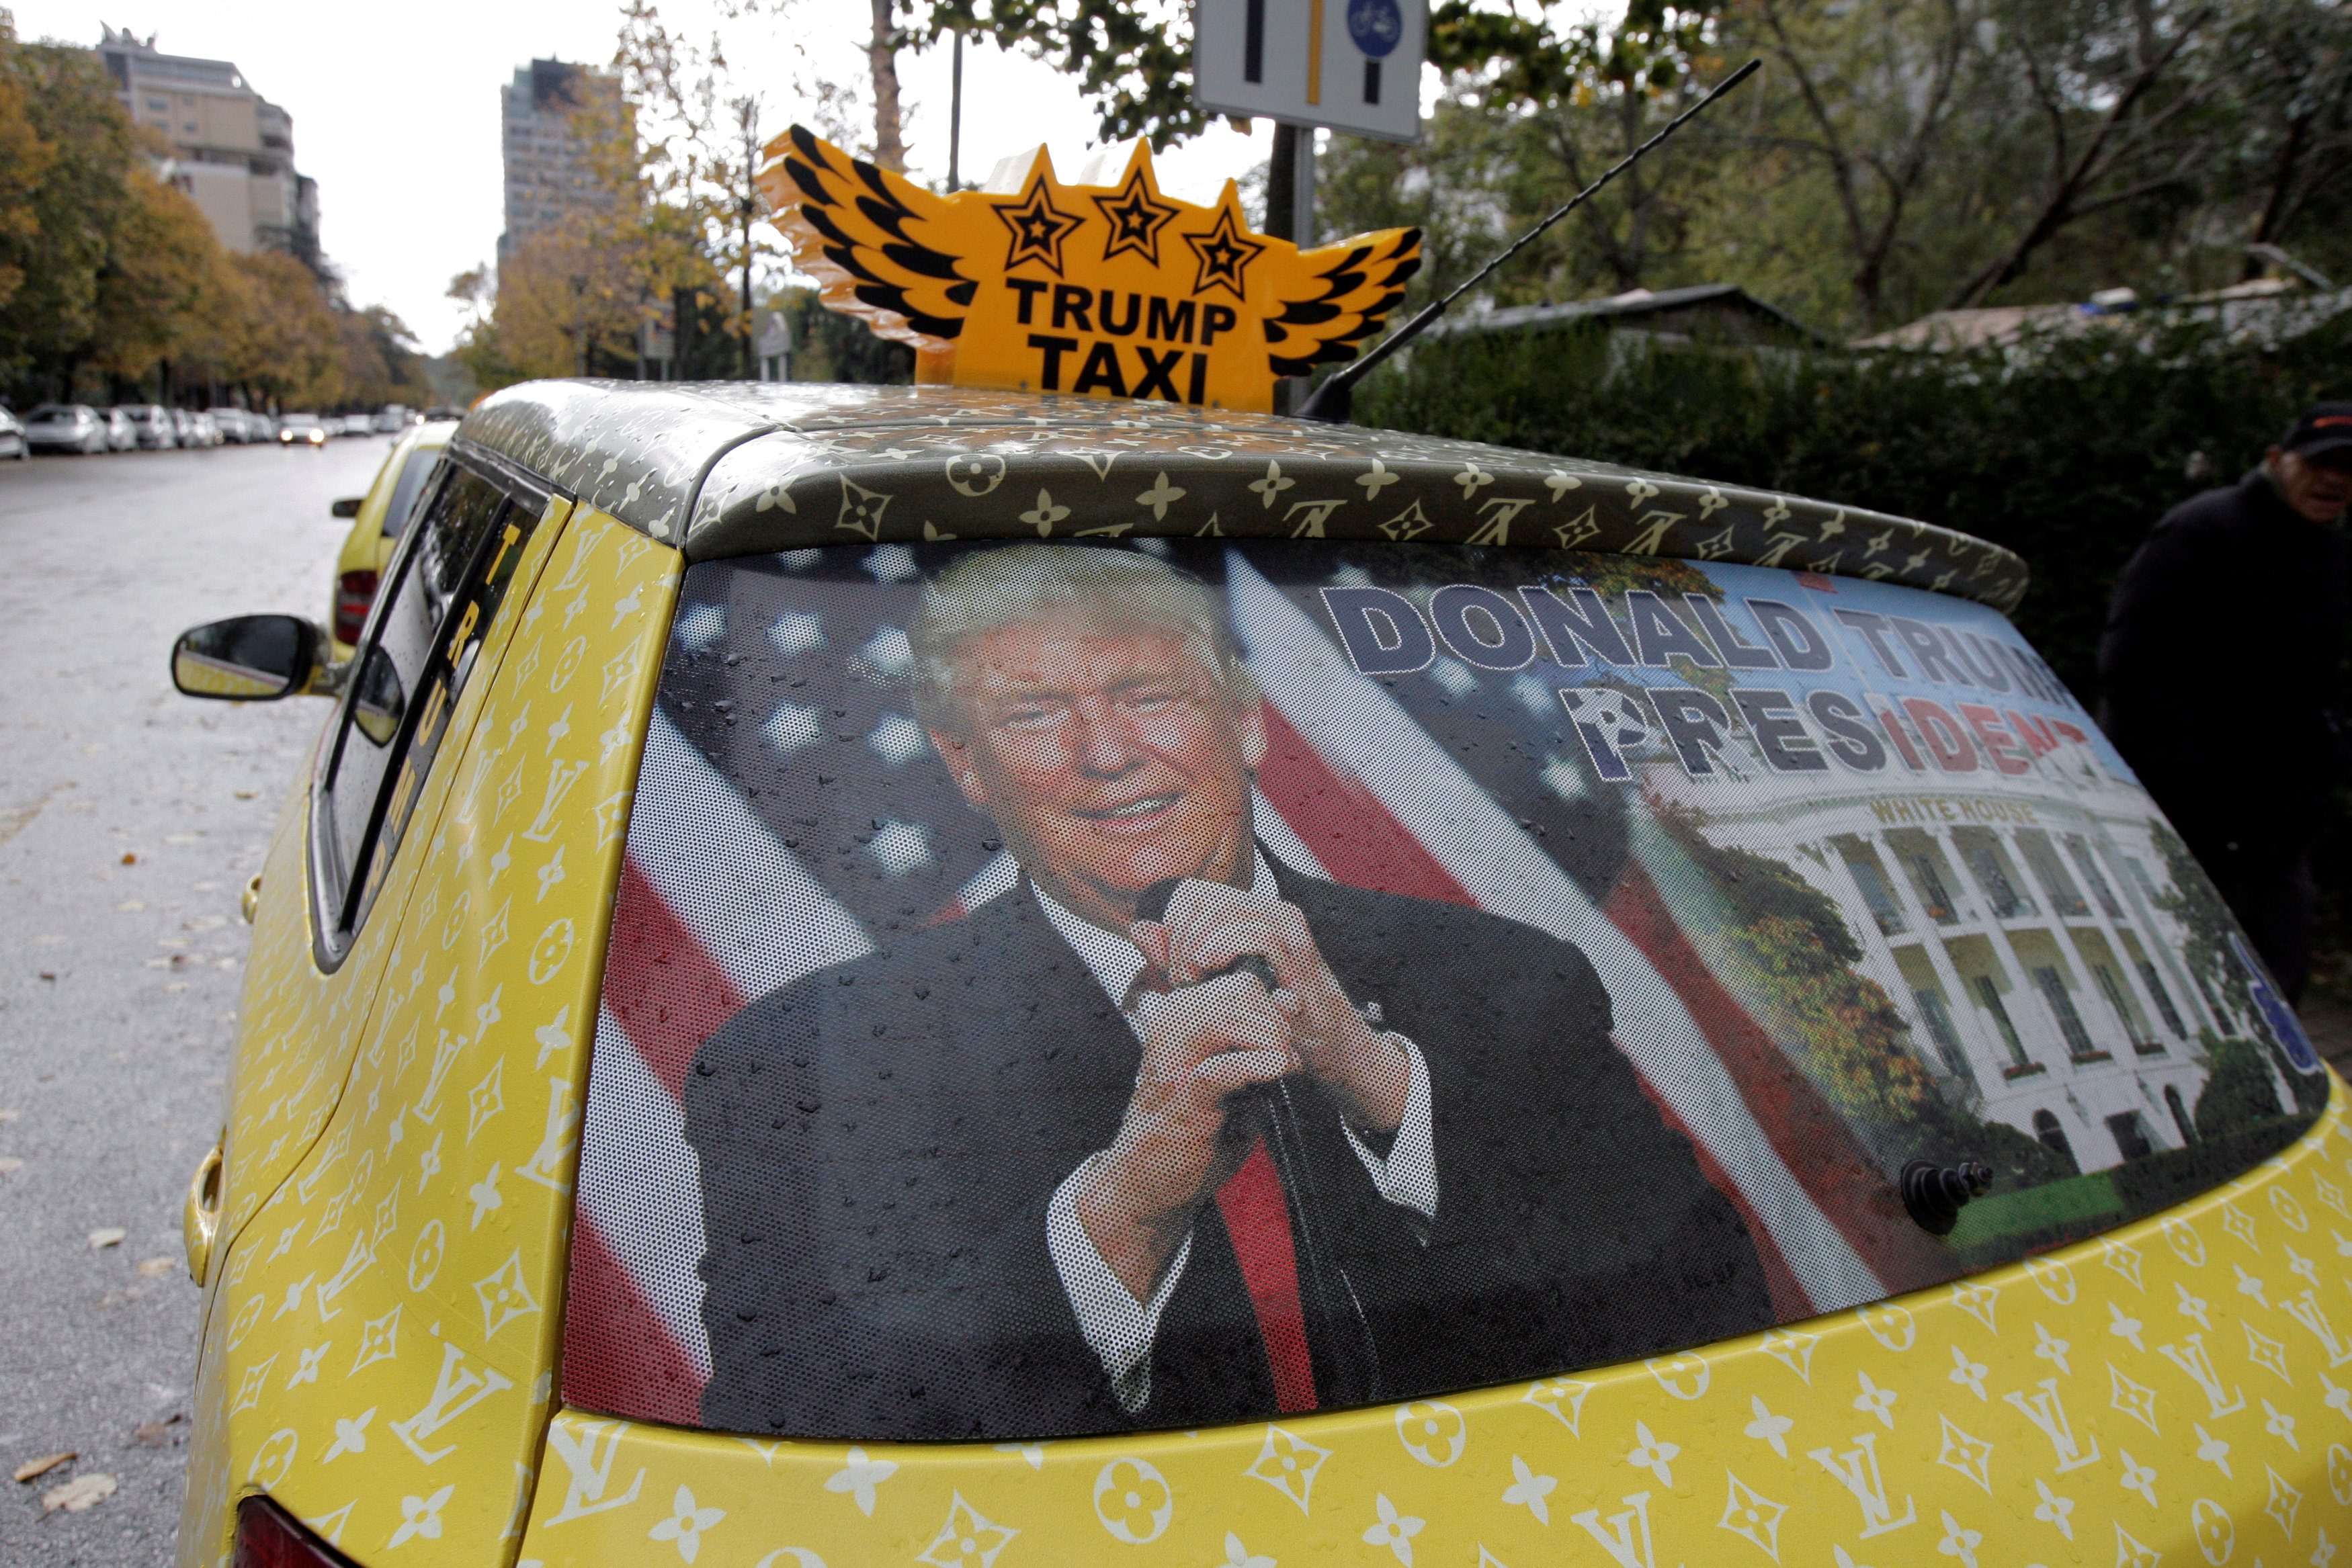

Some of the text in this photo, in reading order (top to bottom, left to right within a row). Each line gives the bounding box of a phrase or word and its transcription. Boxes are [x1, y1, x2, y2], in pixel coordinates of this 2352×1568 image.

[1005, 277, 1236, 346] TRUMP
[1027, 333, 1208, 404] TAXI
[1318, 584, 1833, 674] DONALD
[1559, 687, 2097, 790] PRESIDENT
[1868, 797, 2039, 826] WHITE HOUSE
